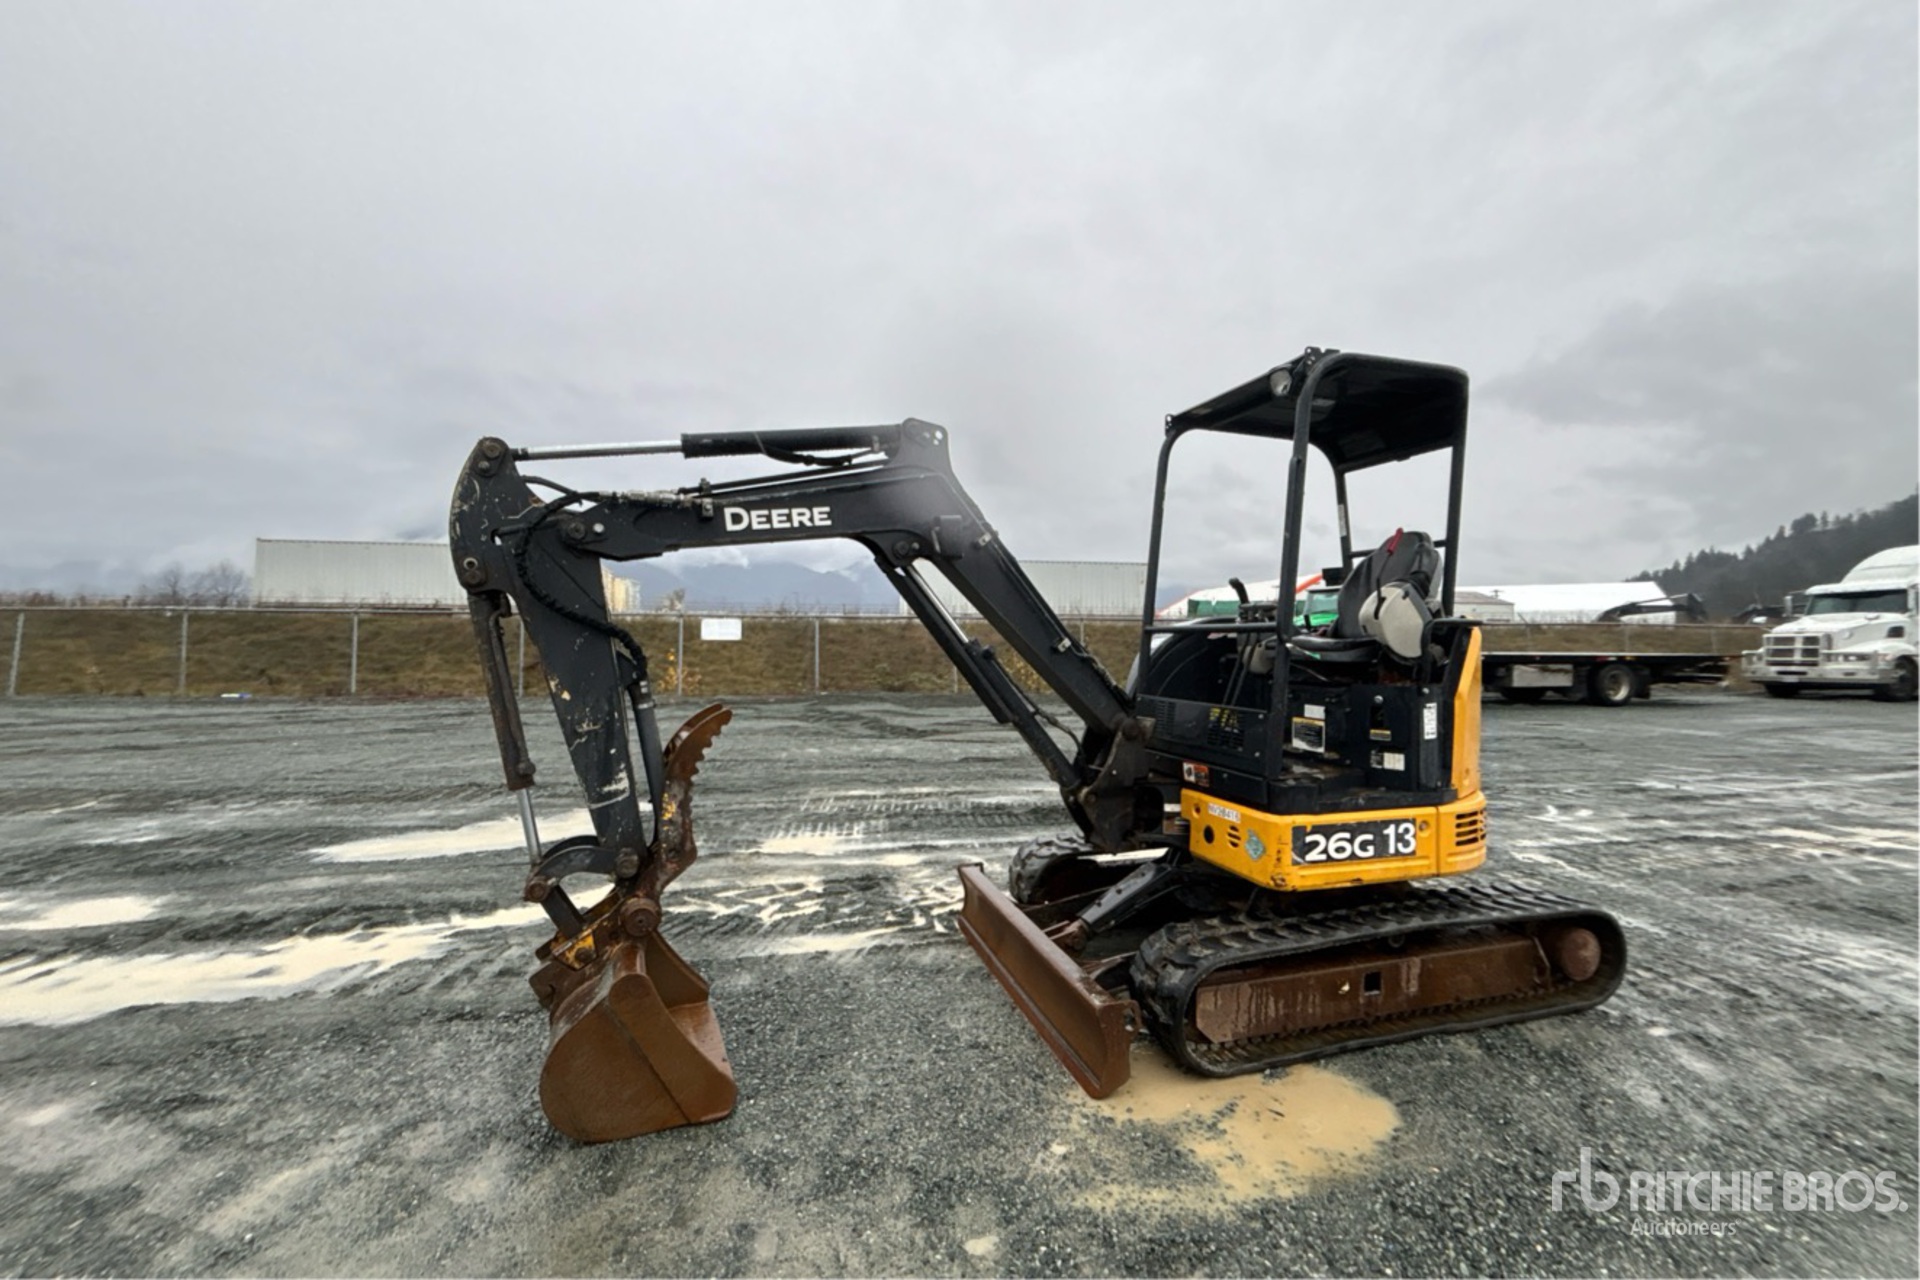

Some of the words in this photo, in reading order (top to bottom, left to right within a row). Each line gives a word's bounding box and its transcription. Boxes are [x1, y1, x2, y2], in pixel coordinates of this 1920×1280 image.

[723, 506, 832, 531] DEERE
[1304, 832, 1375, 861] 26G
[1382, 822, 1416, 854] 13
